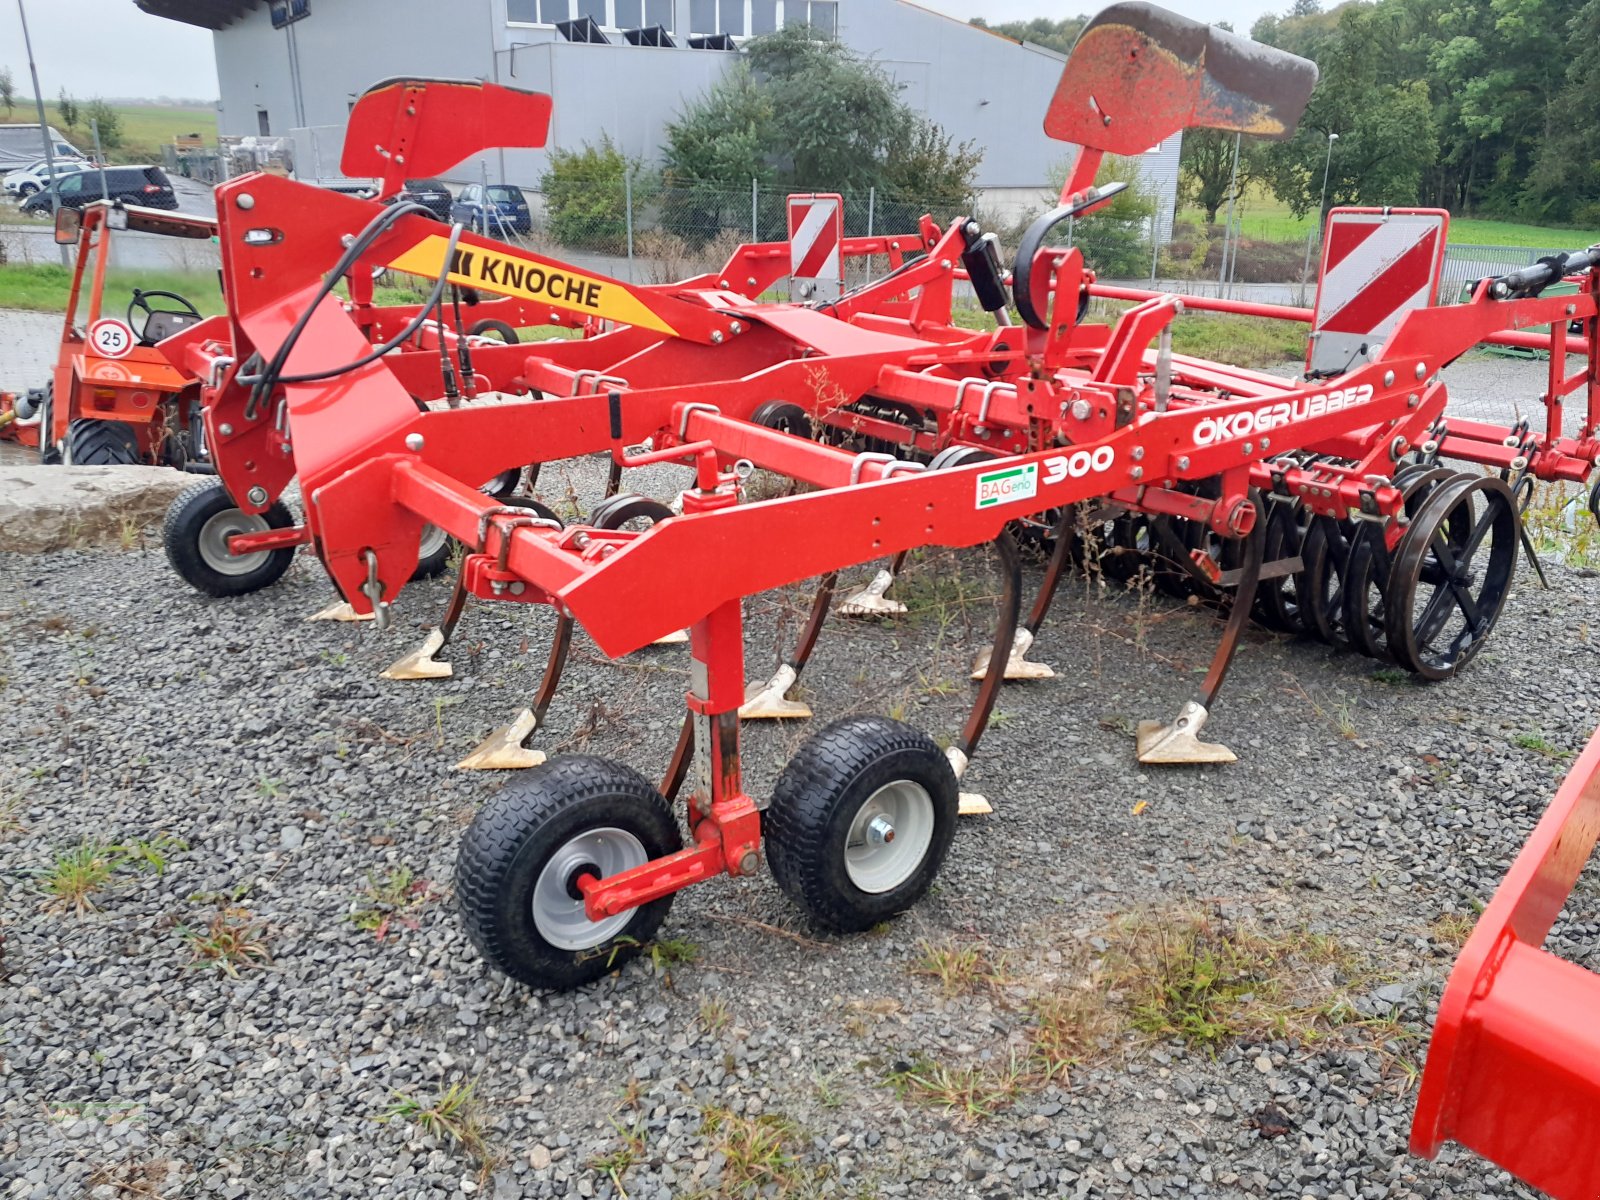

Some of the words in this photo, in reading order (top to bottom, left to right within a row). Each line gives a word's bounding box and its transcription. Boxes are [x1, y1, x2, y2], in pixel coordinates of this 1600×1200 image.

[480, 255, 602, 308] KNOCHE
[102, 331, 121, 347] 25
[1192, 383, 1374, 446] ÖKOGRUBBER
[1042, 445, 1115, 486] 300
